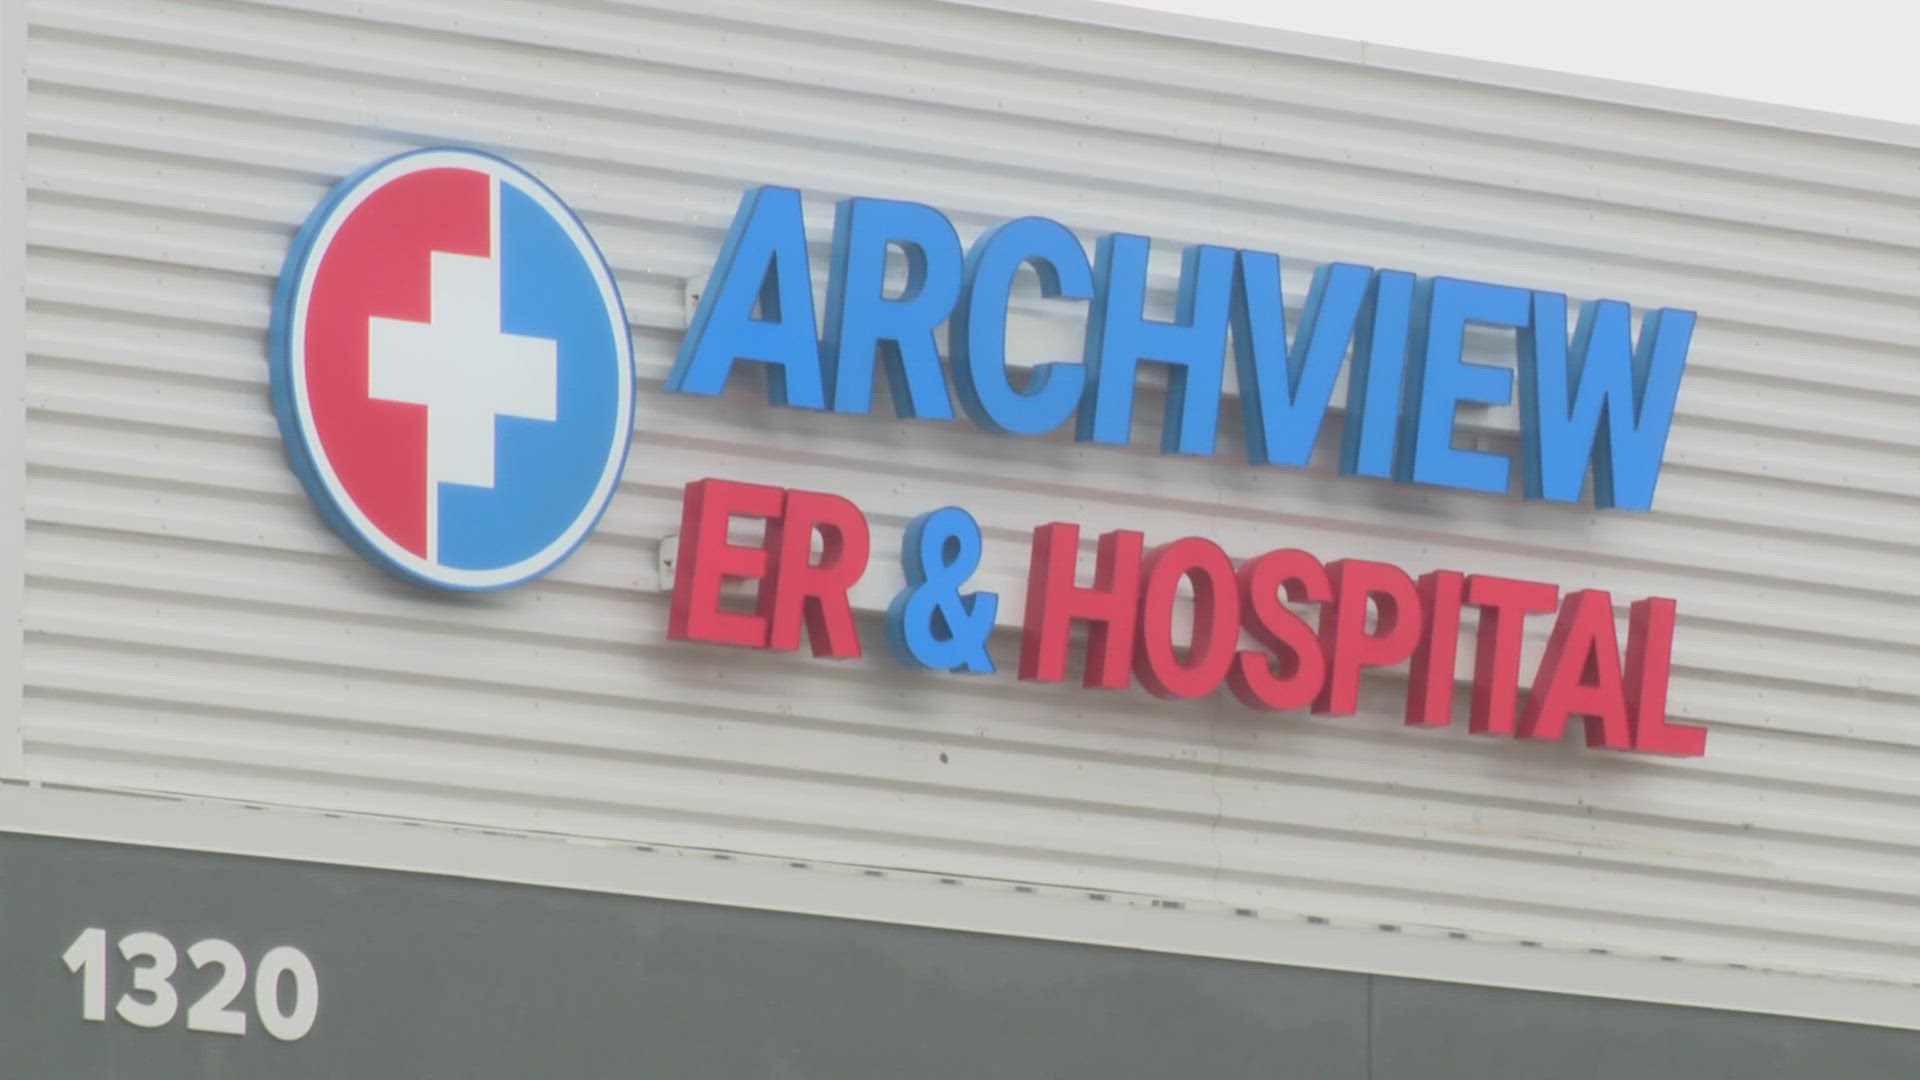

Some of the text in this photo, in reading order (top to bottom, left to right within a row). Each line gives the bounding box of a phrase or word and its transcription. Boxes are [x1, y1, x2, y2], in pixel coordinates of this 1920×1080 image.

[664, 185, 1697, 511] ARCHVIEW
[668, 478, 1708, 757] ER & HOSPITAL
[62, 927, 319, 1042] 1320
